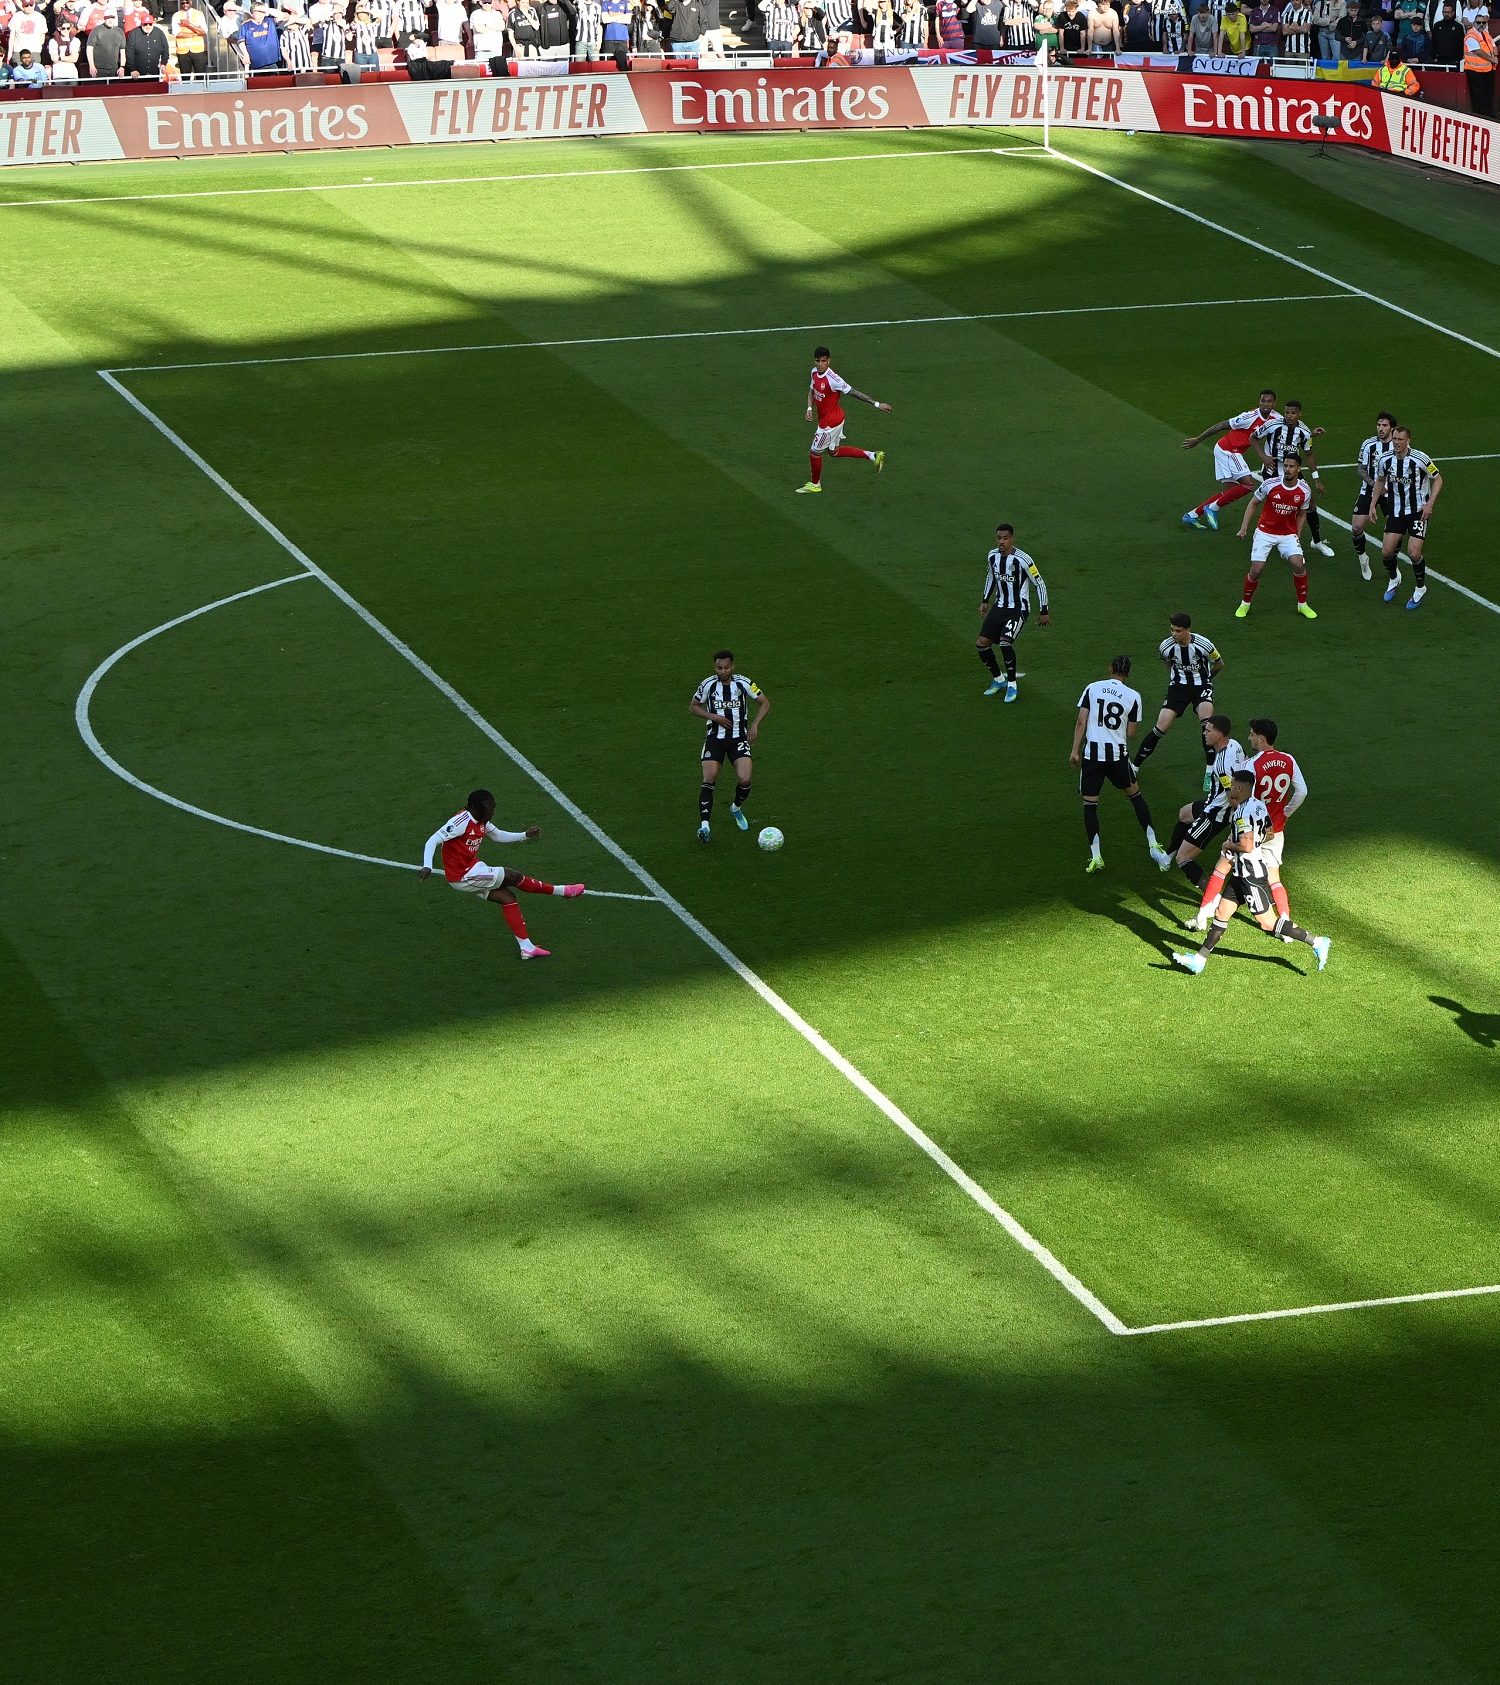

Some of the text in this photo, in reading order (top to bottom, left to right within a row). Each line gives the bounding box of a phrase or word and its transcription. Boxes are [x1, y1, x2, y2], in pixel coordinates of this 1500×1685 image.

[1195, 59, 1252, 76] NUFC
[430, 83, 608, 135] FLY BETTER
[669, 78, 889, 125] Emirates
[949, 74, 1122, 123] FLY BETTER
[1181, 83, 1373, 140] Emirates
[0, 108, 83, 158] TTER
[145, 100, 368, 150] Emirates
[1400, 106, 1490, 174] FLY BETTER
[1413, 520, 1424, 531] 33
[1006, 619, 1018, 632] 41
[1102, 687, 1123, 700] OSULA
[1200, 689, 1213, 698] 67
[1096, 698, 1125, 731] 18
[1262, 760, 1287, 772] HAVERTZ
[1260, 773, 1291, 805] 29
